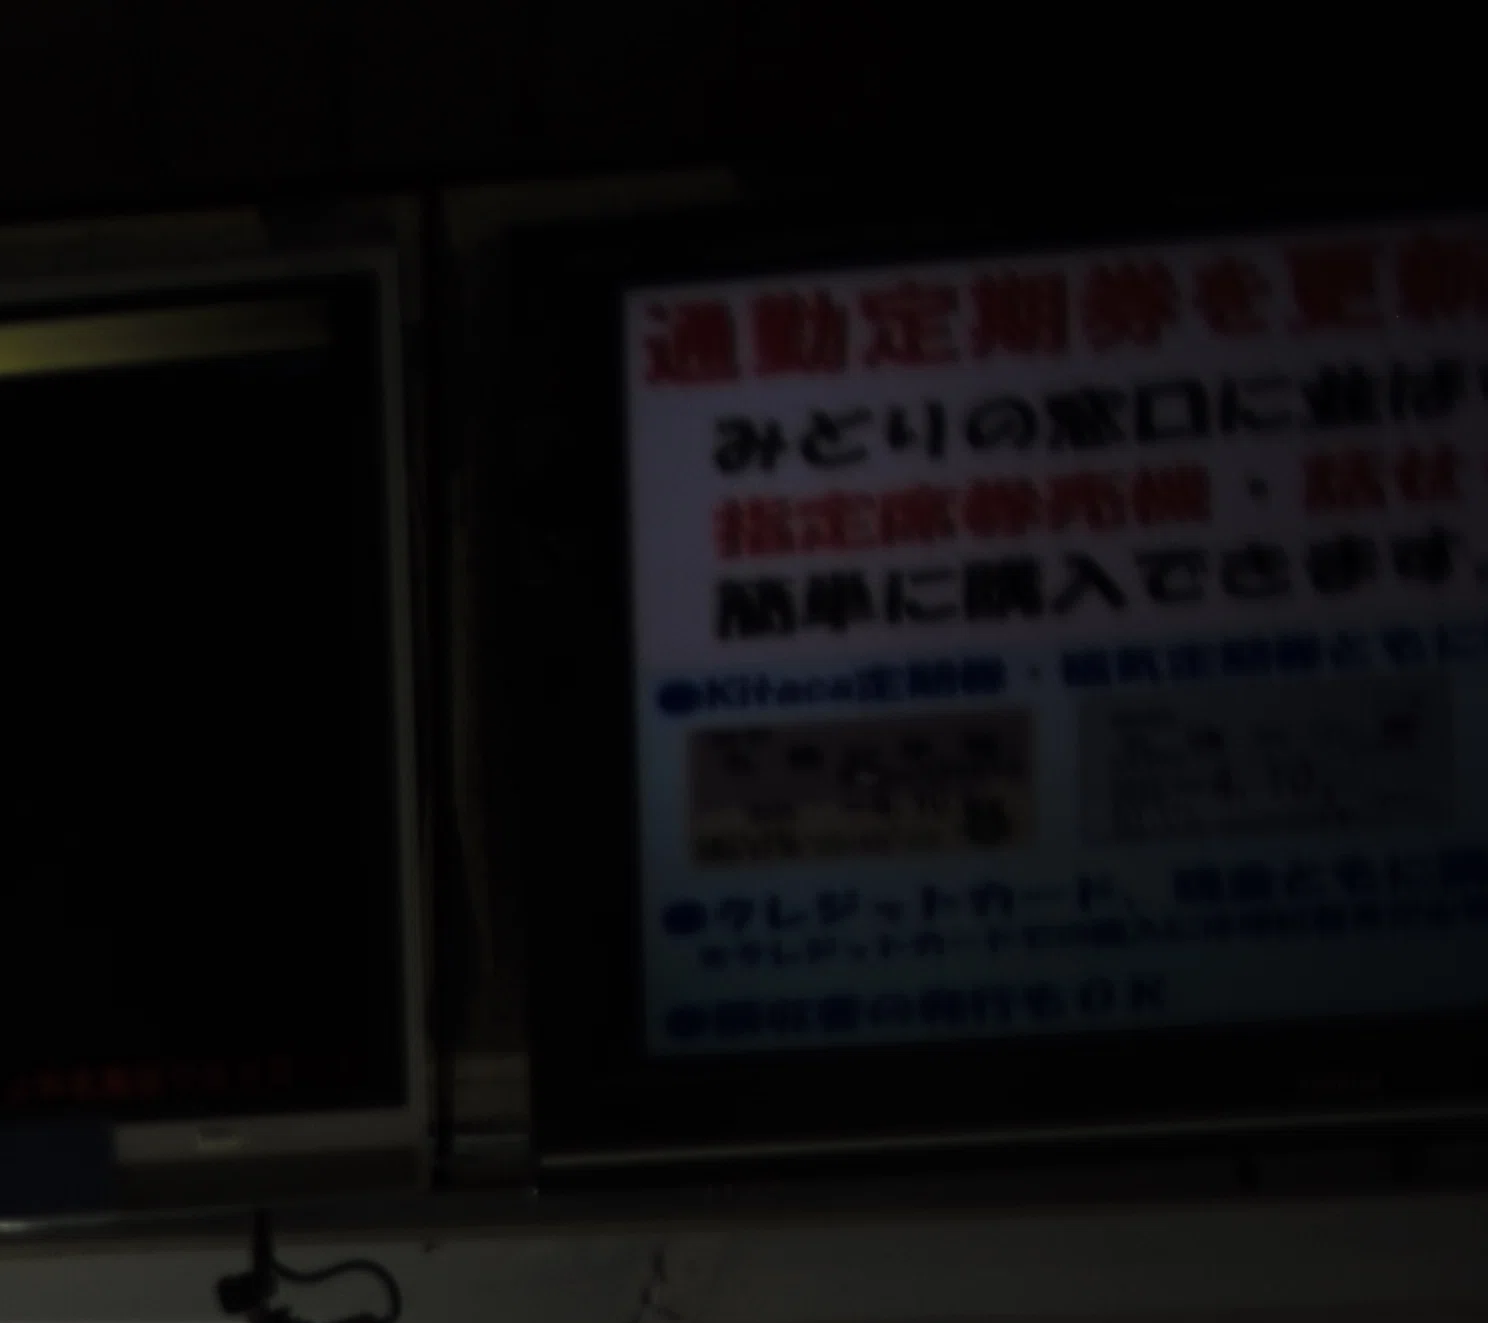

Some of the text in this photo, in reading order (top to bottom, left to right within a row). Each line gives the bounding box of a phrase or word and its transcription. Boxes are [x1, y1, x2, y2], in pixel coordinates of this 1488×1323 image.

[714, 361, 1488, 475] みどりの窓口に並ば
